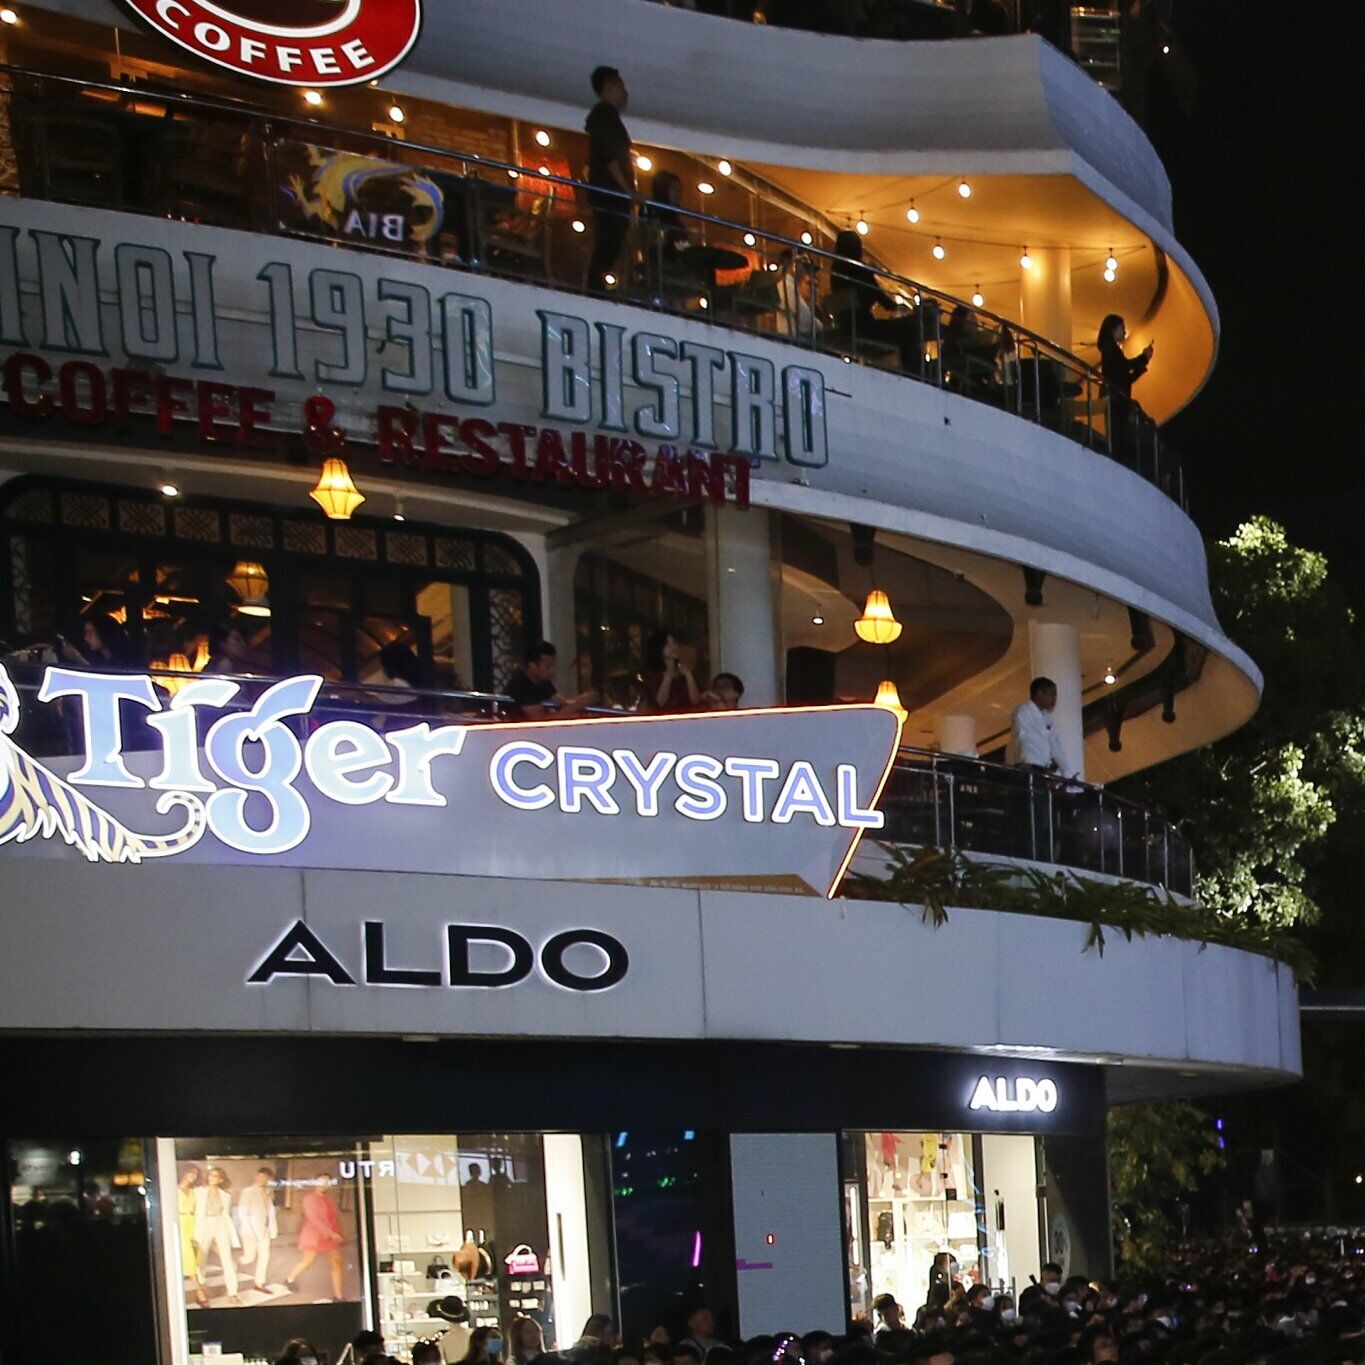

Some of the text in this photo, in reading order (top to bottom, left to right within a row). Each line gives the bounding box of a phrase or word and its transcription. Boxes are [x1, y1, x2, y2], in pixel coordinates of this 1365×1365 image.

[155, 0, 376, 75] COFFEE
[256, 261, 497, 407] 1930
[534, 308, 829, 469] BISTRO
[3, 352, 753, 507] COFFEE & RESTAURANT
[40, 666, 886, 855] Tiger CRYSTAL
[246, 918, 631, 993] ALDO
[969, 1076, 1059, 1113] ALDO
